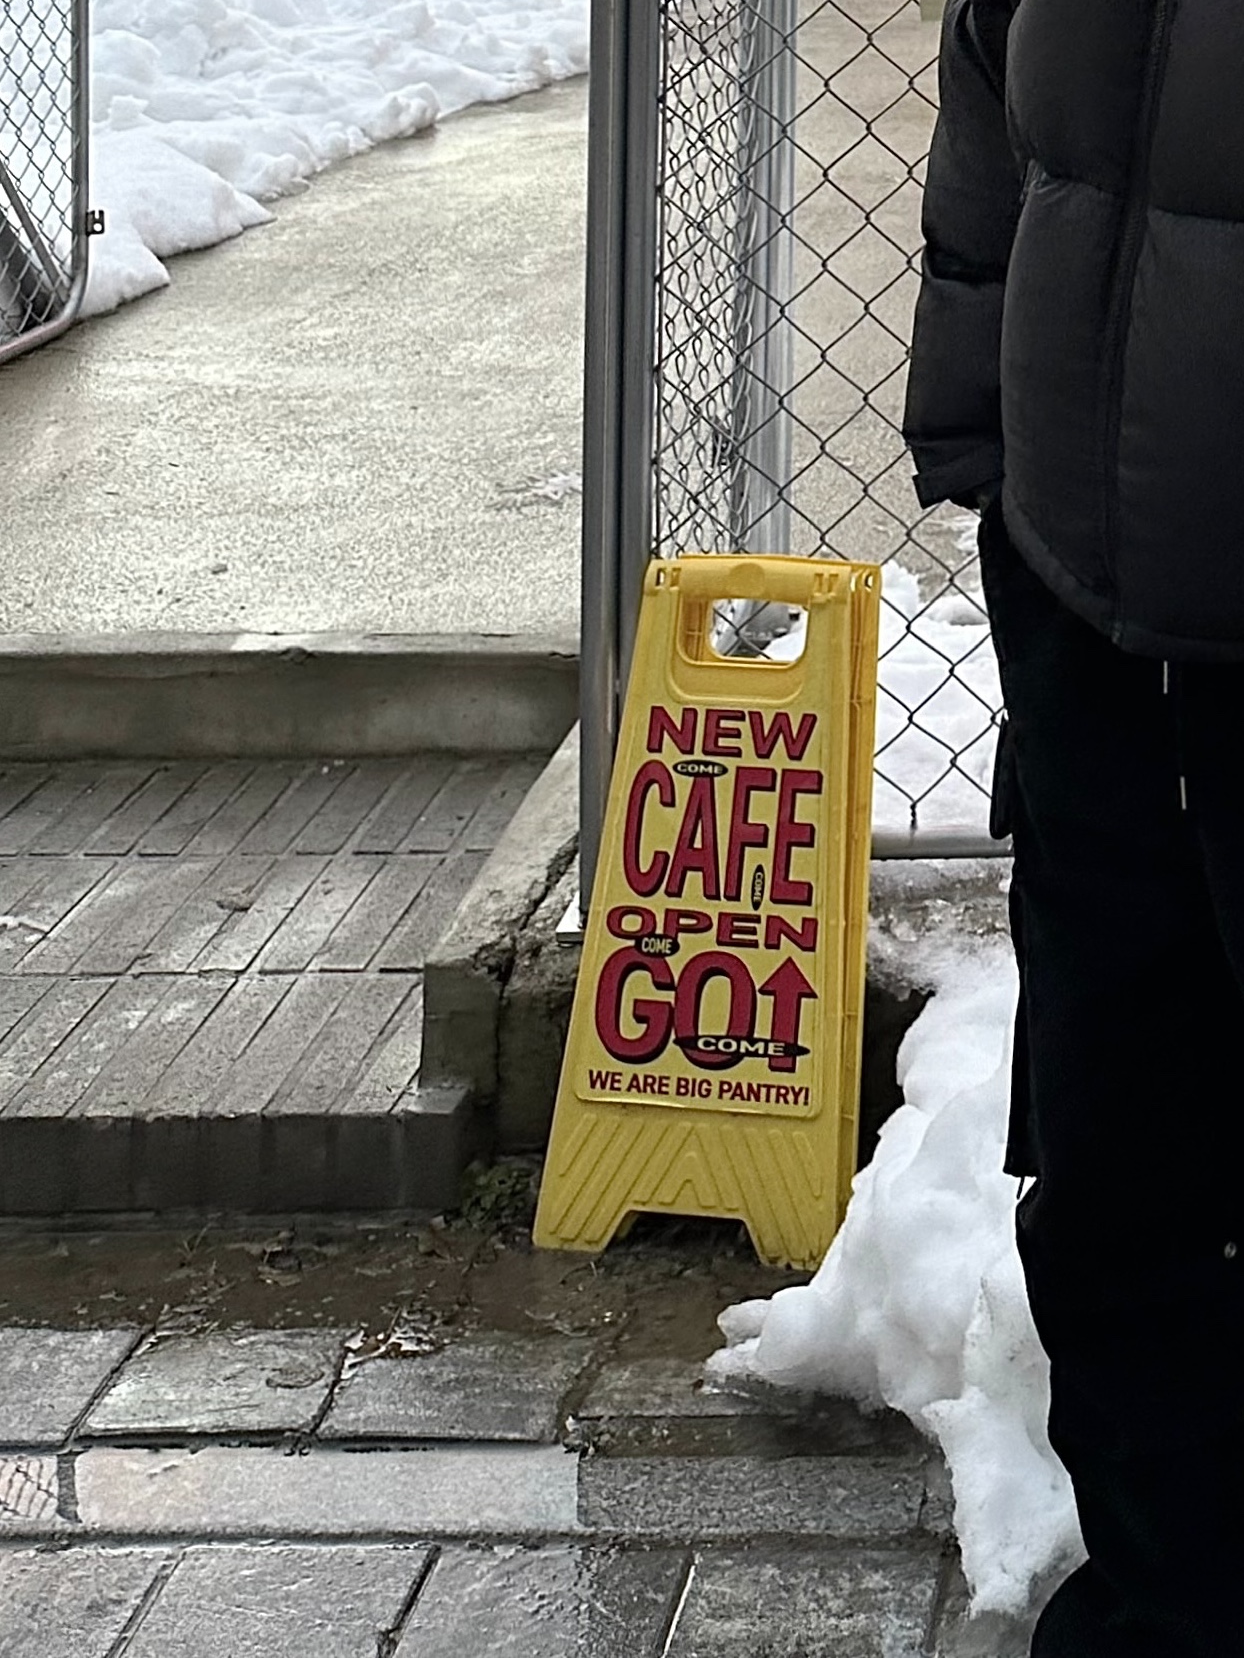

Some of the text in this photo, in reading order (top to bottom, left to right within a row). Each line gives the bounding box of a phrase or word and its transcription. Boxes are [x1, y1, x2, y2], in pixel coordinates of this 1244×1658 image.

[647, 706, 817, 760] NEW
[676, 763, 723, 775] COME
[623, 760, 823, 906] CAFE
[605, 906, 818, 951] OPEN
[641, 938, 672, 954] COME
[595, 946, 756, 1070] GO
[697, 1036, 785, 1056] COME
[588, 1069, 810, 1106] WE ARE BIG PANTRY!
